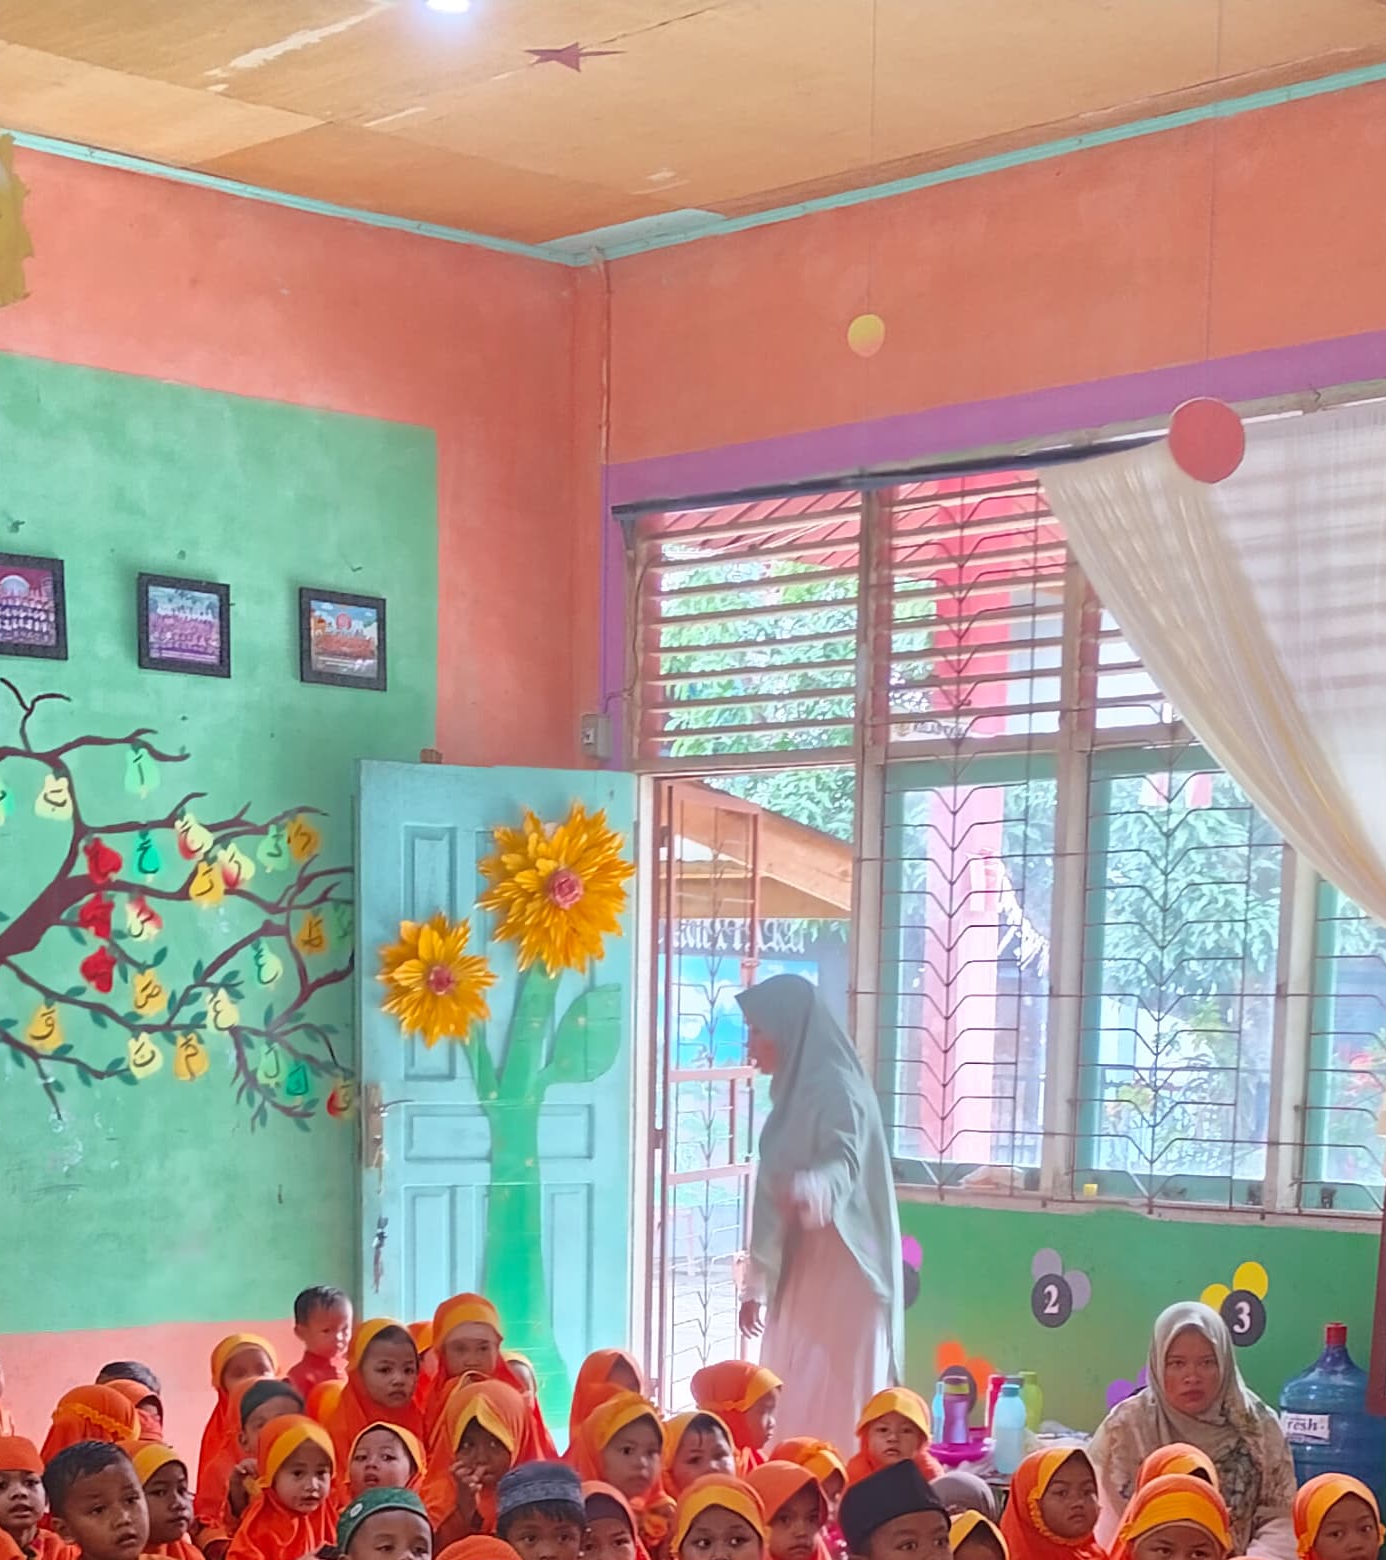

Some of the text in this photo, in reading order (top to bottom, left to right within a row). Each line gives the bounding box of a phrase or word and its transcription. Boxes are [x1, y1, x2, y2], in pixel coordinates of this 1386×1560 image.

[1043, 1284, 1061, 1314] 2
[1233, 1302, 1251, 1333] 3
[1286, 1418, 1317, 1431] resh
